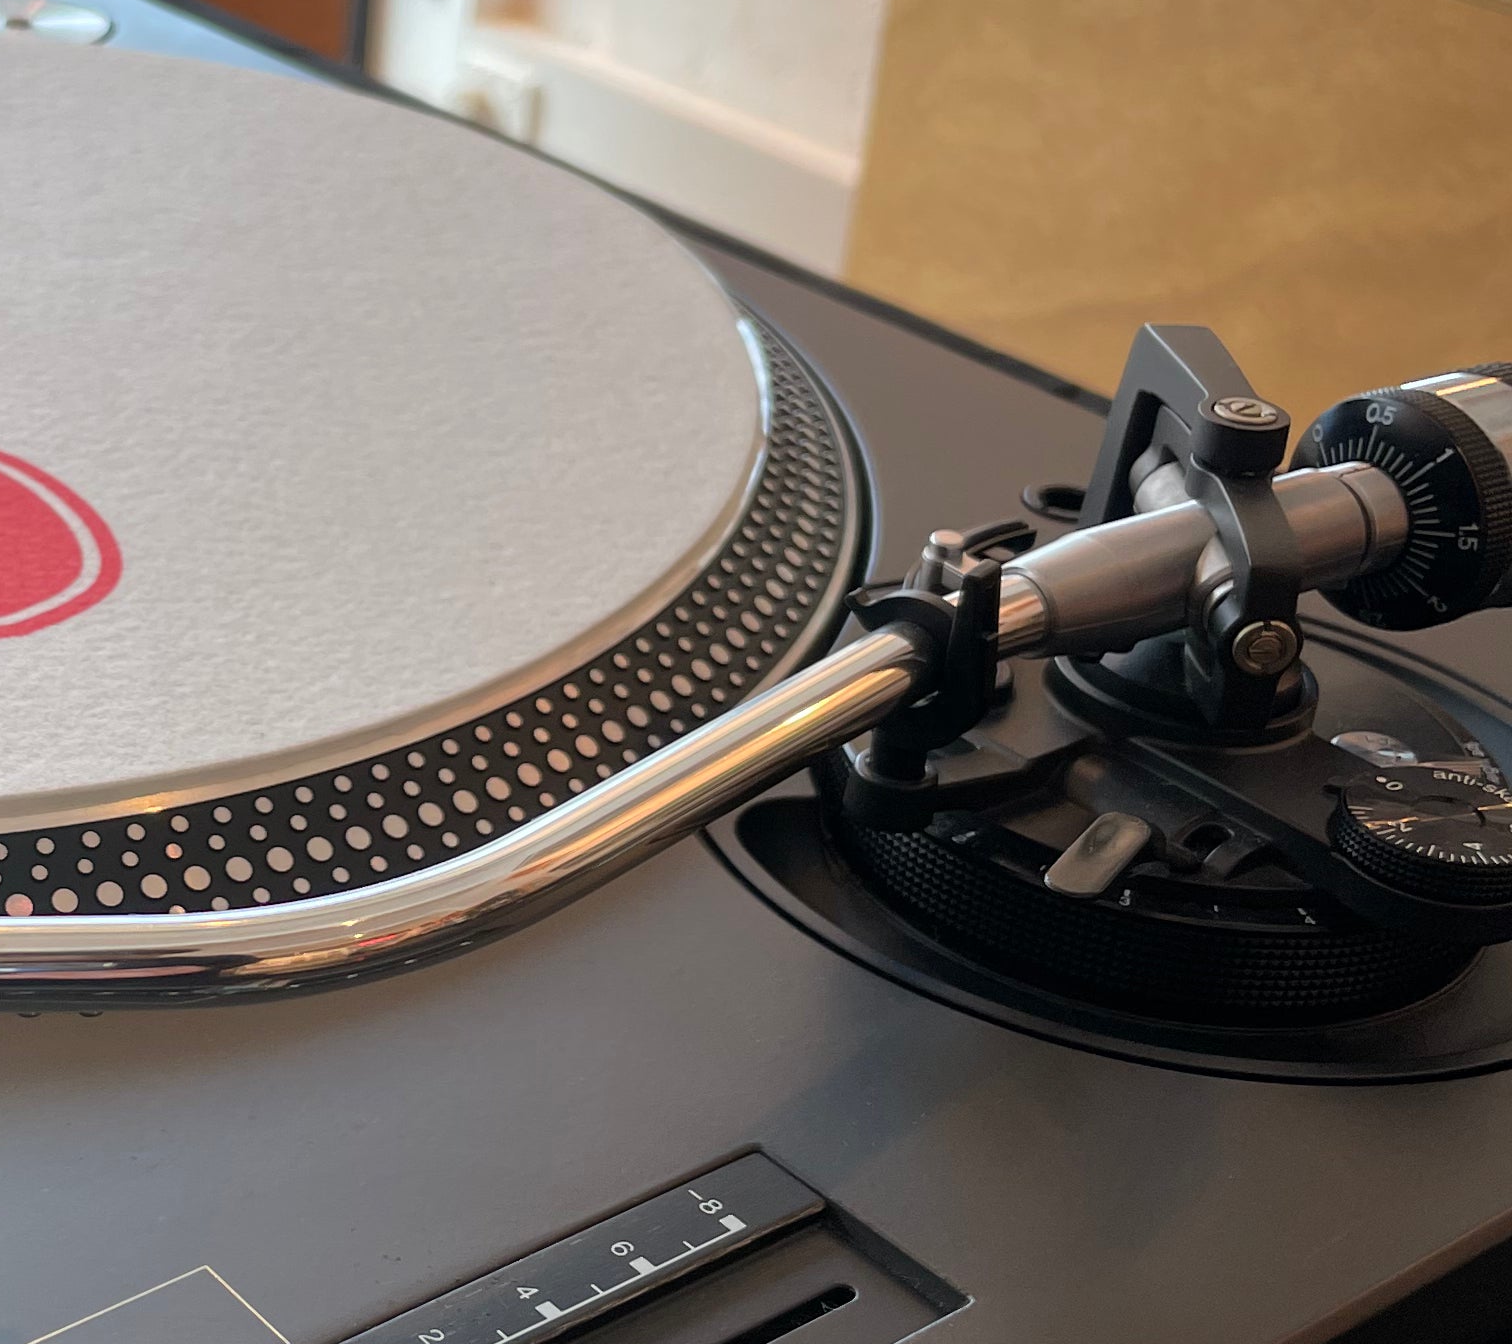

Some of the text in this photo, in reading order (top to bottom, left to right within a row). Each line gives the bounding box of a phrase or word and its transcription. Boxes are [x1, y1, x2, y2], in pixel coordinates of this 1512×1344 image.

[1457, 523, 1480, 552] 1.5
[610, 1240, 635, 1257] 6
[515, 1285, 540, 1301] 4
